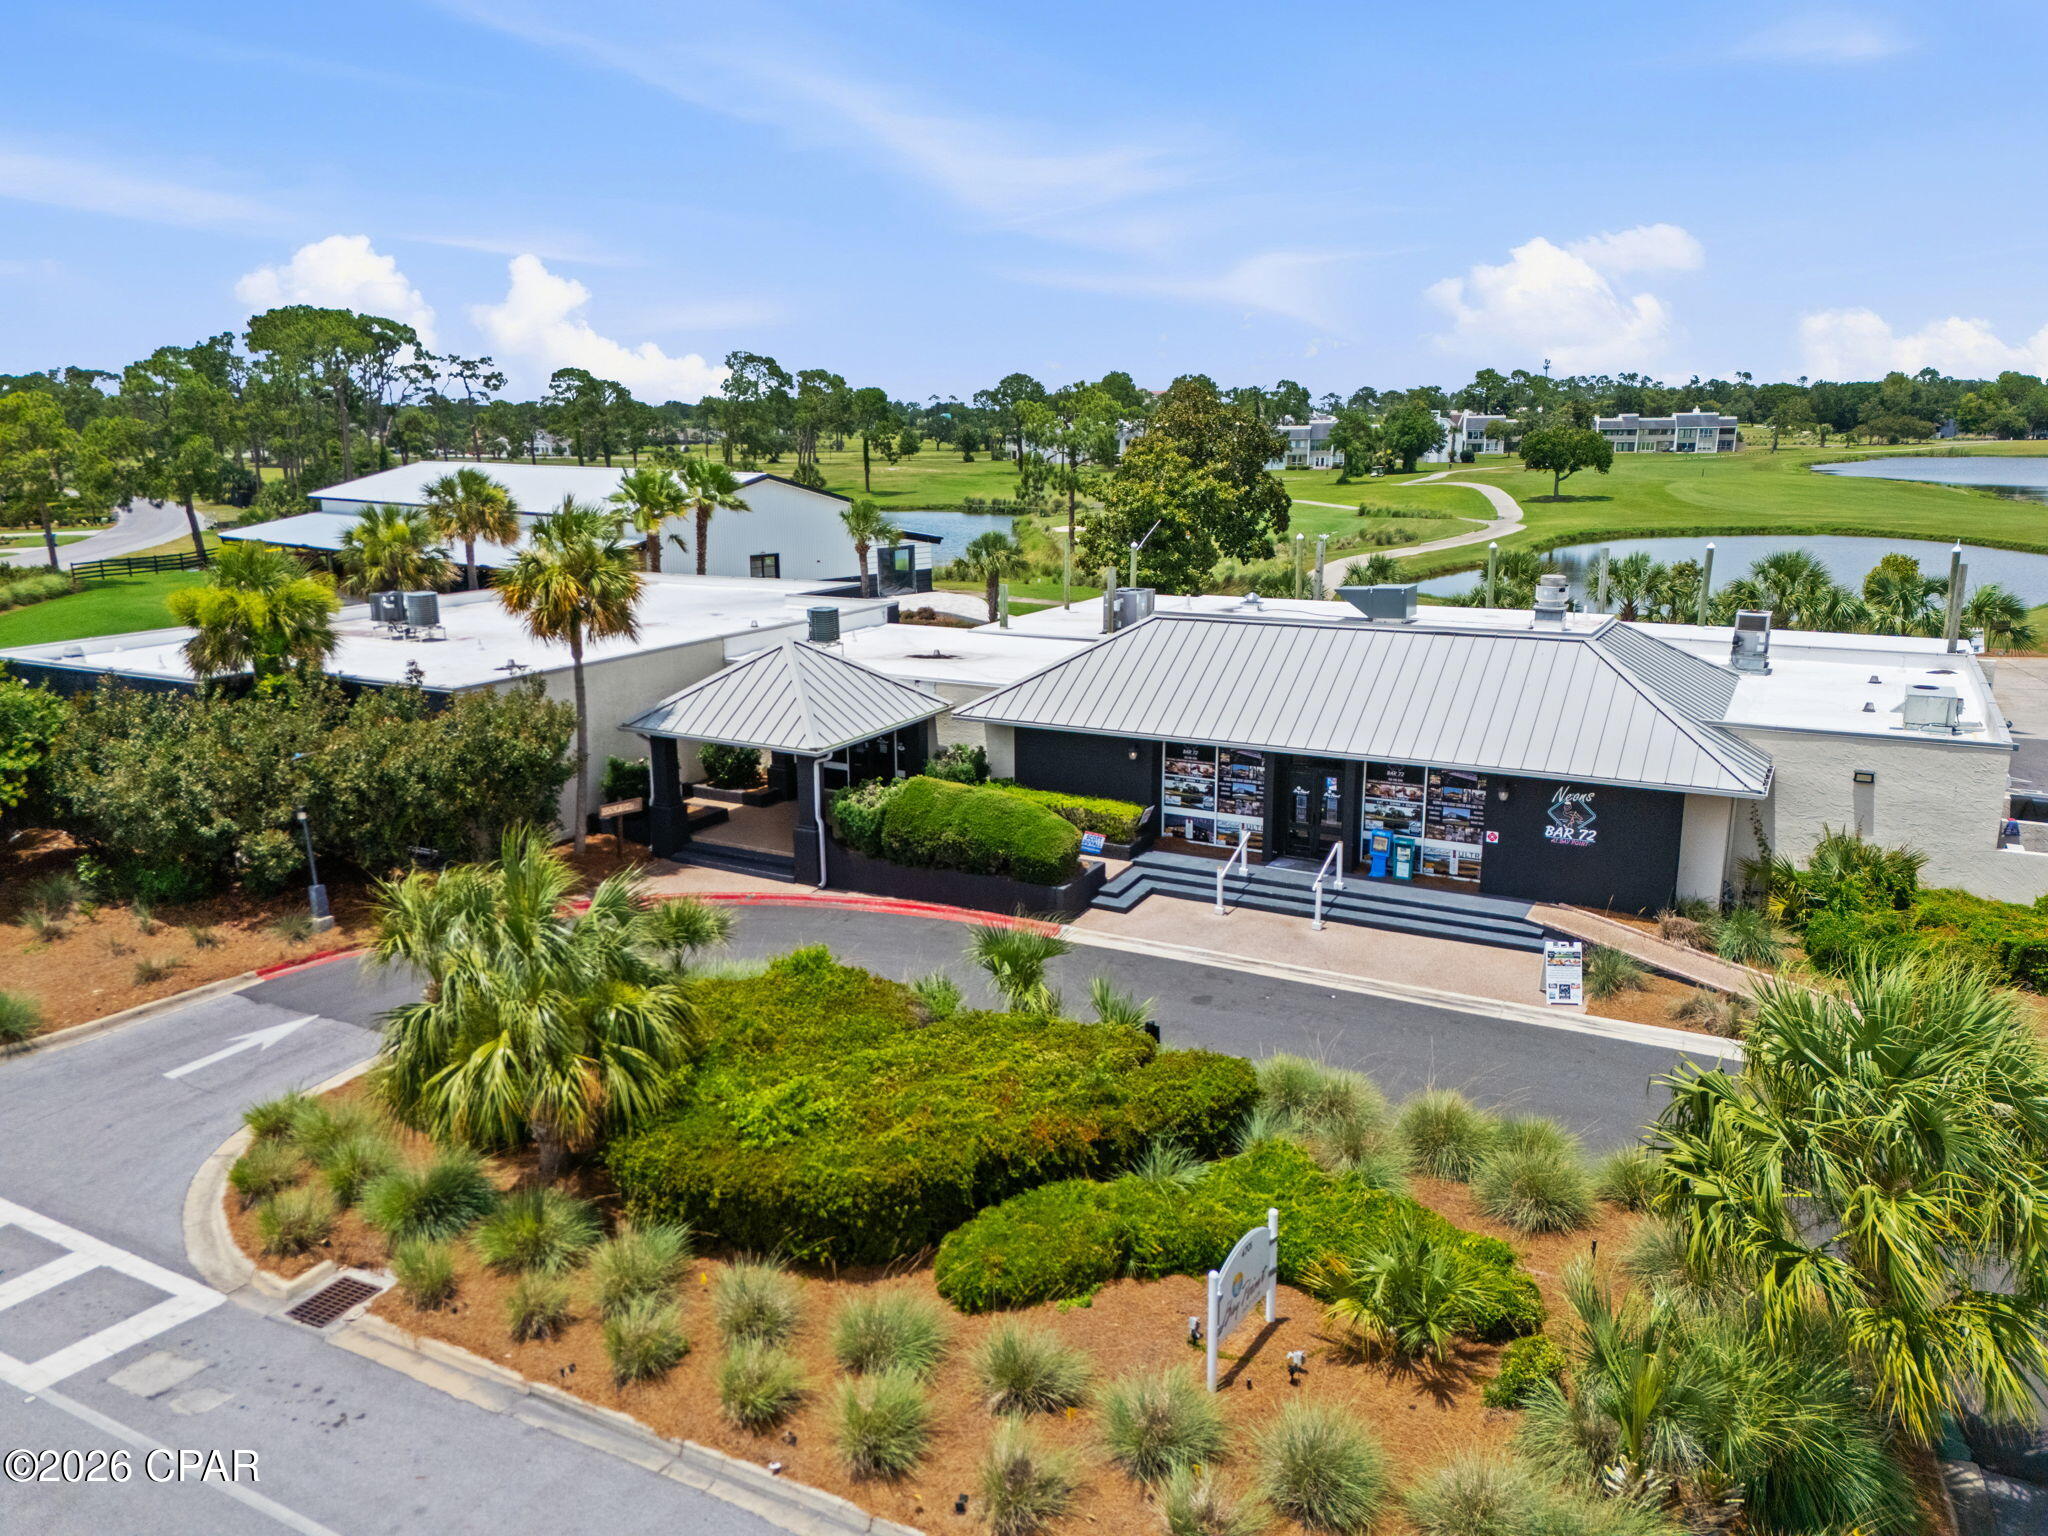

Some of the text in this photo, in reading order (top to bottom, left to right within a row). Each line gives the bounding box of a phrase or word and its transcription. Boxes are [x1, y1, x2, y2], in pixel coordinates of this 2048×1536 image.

[1552, 786, 1595, 802] Neons
[1545, 825, 1597, 841] BAR 72
